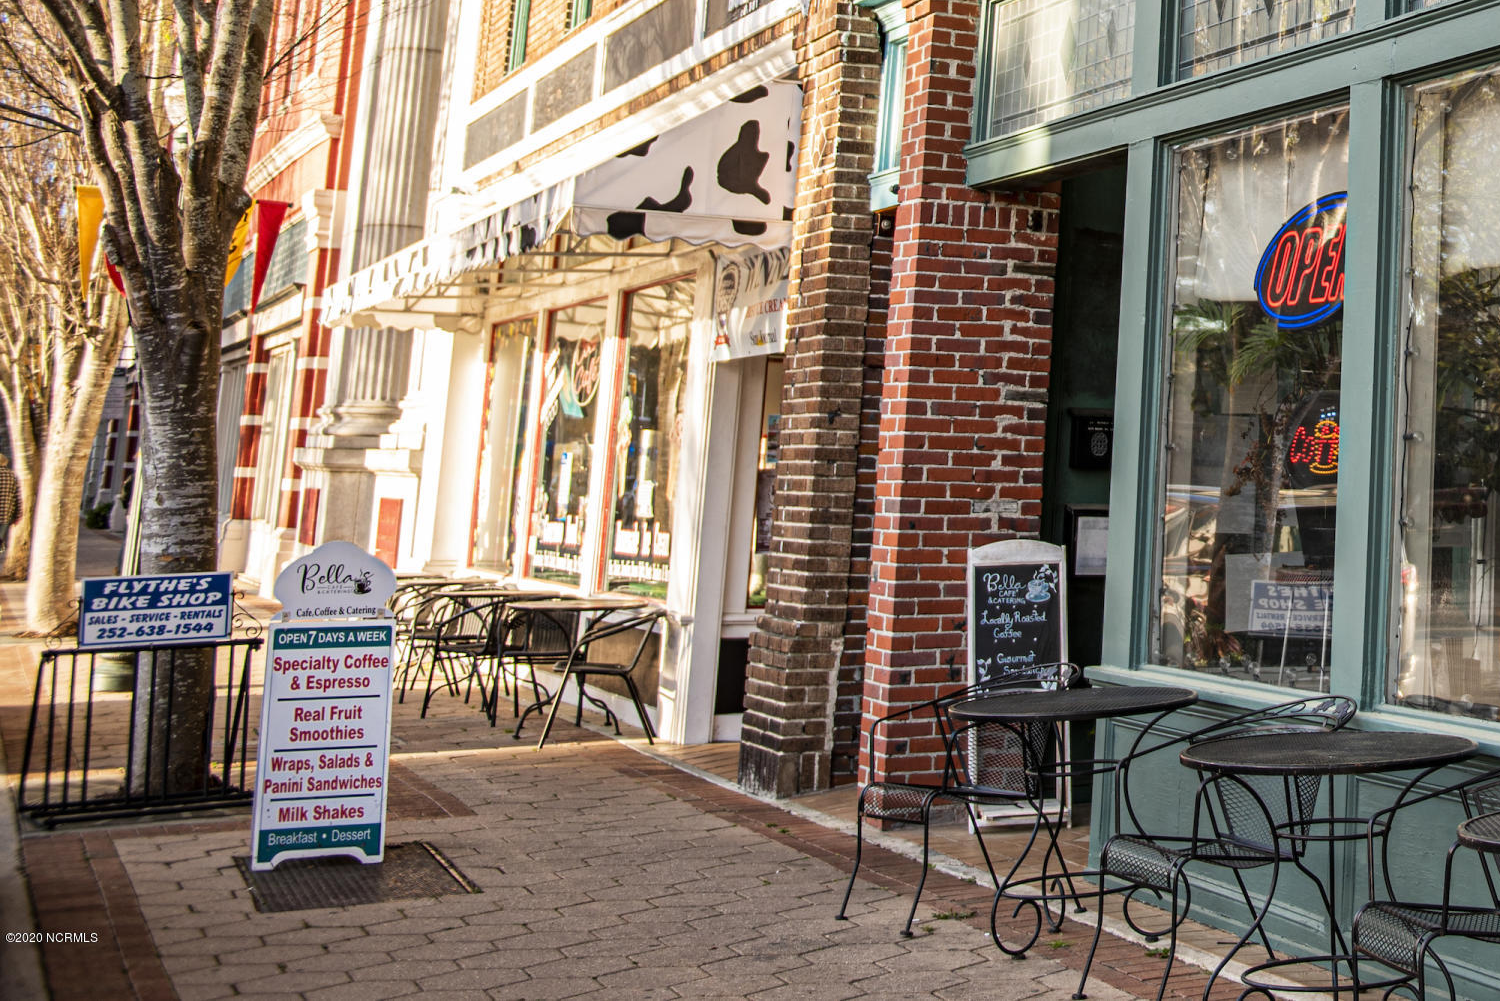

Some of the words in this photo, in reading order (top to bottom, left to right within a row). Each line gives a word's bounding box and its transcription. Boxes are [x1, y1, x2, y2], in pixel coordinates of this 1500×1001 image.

[103, 577, 212, 595] FLYTHE'S
[90, 595, 152, 610] BIKE
[157, 591, 222, 606] SHOP
[88, 614, 119, 625] SALES
[129, 611, 171, 623] SERVICE
[180, 608, 223, 620] RENTALS
[346, 605, 376, 615] Catering
[96, 622, 214, 639] 252-638-1544
[278, 633, 307, 644] OPEN
[308, 630, 317, 645] 7
[318, 632, 345, 643] DAYS
[347, 632, 355, 642] A
[357, 630, 387, 642] WEEK
[273, 656, 339, 675] Specialty
[344, 654, 389, 669] Coffee
[290, 675, 300, 690] &
[306, 675, 370, 692] Espresso
[294, 706, 325, 722] Real
[330, 705, 362, 720] Fruit
[289, 725, 364, 742] Smoothies
[271, 756, 314, 774] Wraps,
[318, 753, 360, 769] Salads
[364, 752, 373, 767] &
[264, 777, 303, 794] Panini
[307, 774, 382, 791] Sandwiches
[278, 806, 308, 822] Milk
[313, 804, 365, 820] Shakes
[267, 831, 317, 845] Breakfast
[331, 828, 371, 842] Dessert
